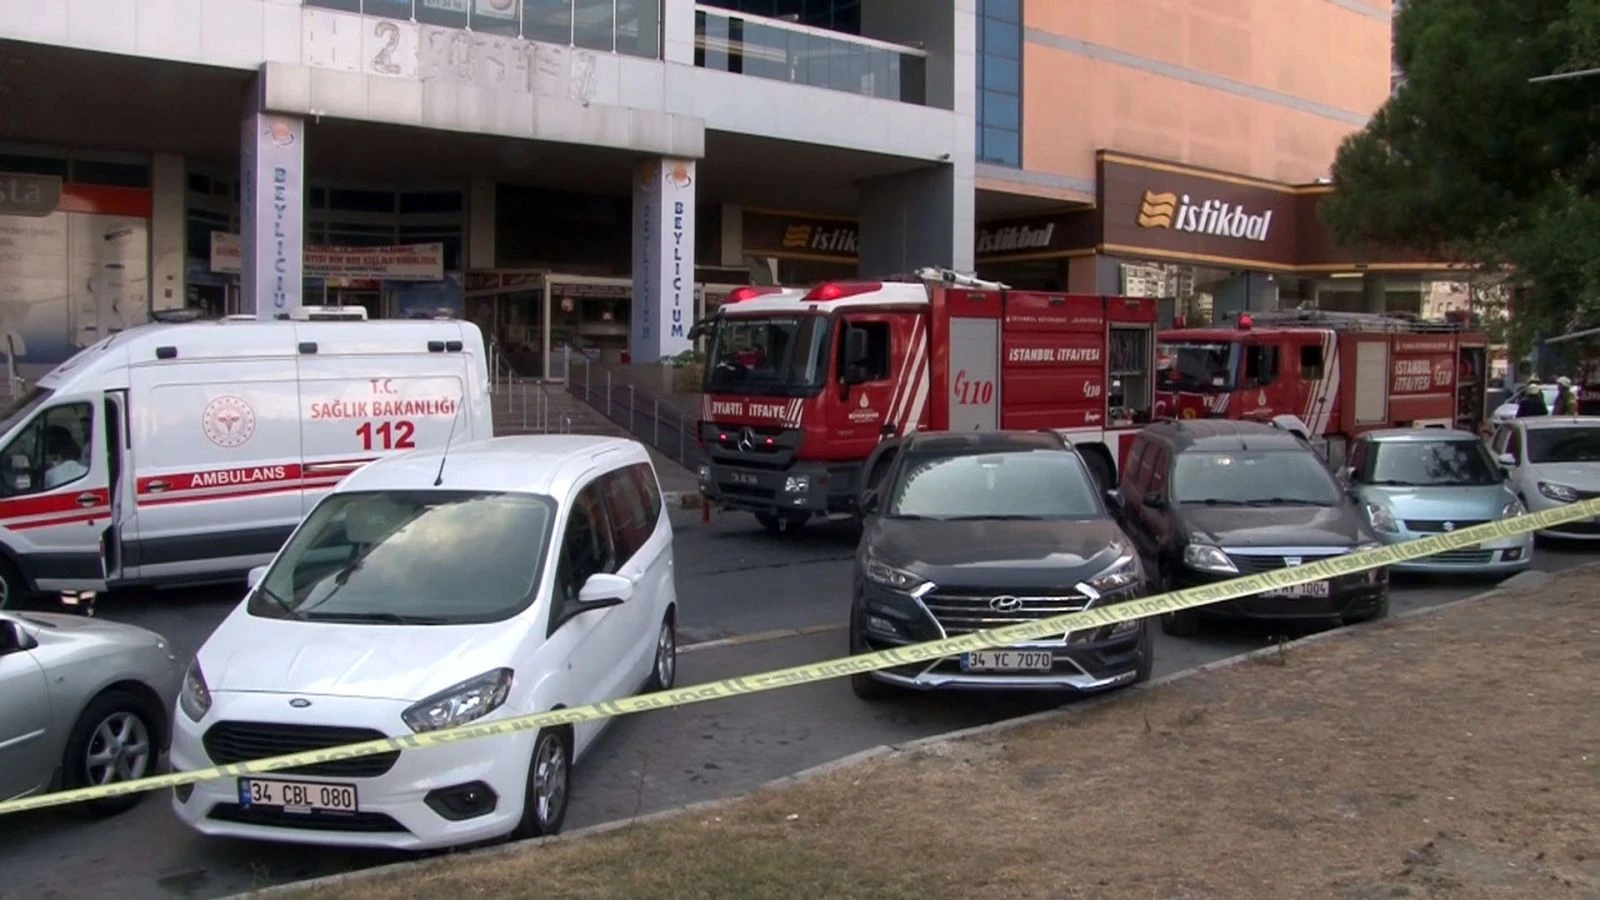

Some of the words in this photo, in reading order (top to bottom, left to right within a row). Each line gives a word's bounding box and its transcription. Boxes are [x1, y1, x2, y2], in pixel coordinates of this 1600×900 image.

[1175, 194, 1272, 241] istikbal
[811, 226, 860, 252] istik
[976, 223, 1055, 250] istikbal
[671, 201, 684, 337] BEYLICIUM
[1008, 348, 1054, 361] İSTANBUL
[1057, 348, 1100, 361] İTFAİYESİ
[369, 378, 398, 394] T.C.
[957, 380, 993, 405] 110
[311, 399, 368, 419] SAĞLIK
[372, 397, 455, 417] BAKANLIĞI
[748, 403, 786, 418] İTFAİYE
[356, 421, 415, 450] 112
[191, 466, 285, 487] AMBULANS
[1301, 583, 1326, 593] 1004
[970, 653, 985, 666] 34
[994, 653, 1010, 666] YC
[1017, 653, 1049, 666] 7070
[252, 783, 272, 802] 34
[282, 785, 313, 805] CBL
[320, 787, 352, 808] 080
